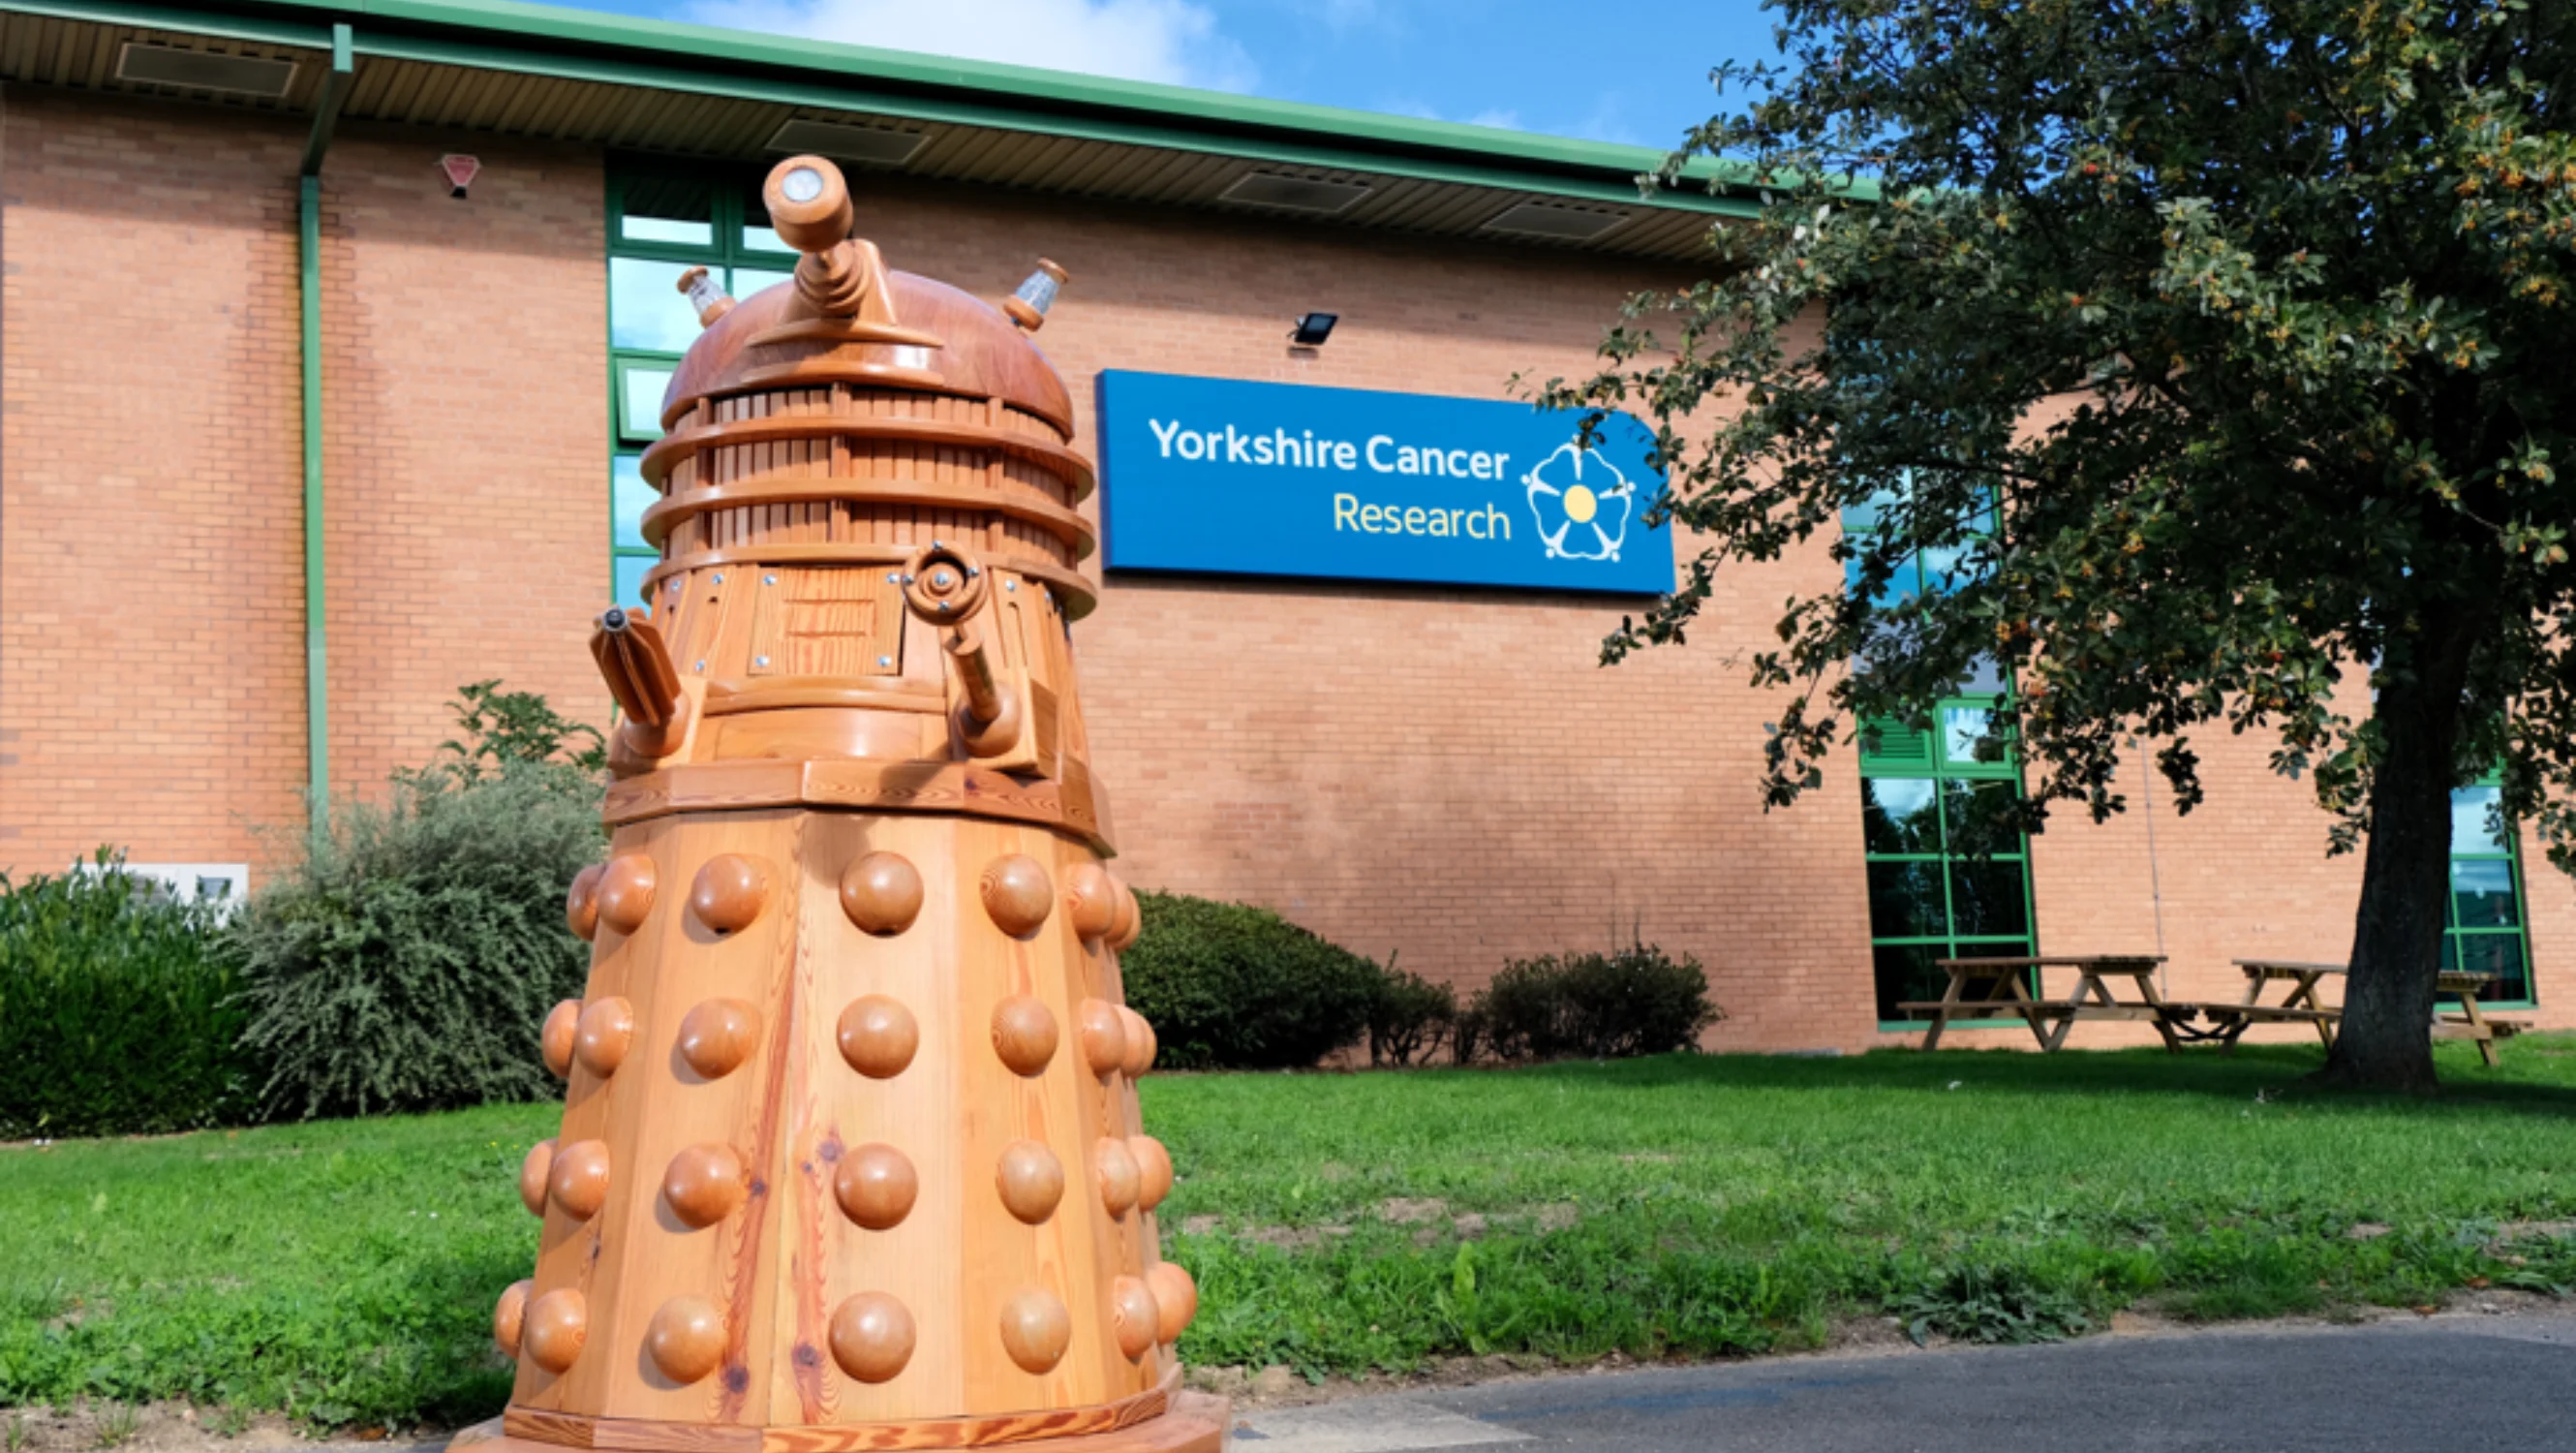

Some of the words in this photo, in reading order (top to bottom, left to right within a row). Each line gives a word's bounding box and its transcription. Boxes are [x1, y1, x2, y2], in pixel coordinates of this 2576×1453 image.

[1149, 418, 1357, 470] Yorkshire
[1365, 435, 1510, 479] Cancer
[1334, 493, 1511, 540] Research
